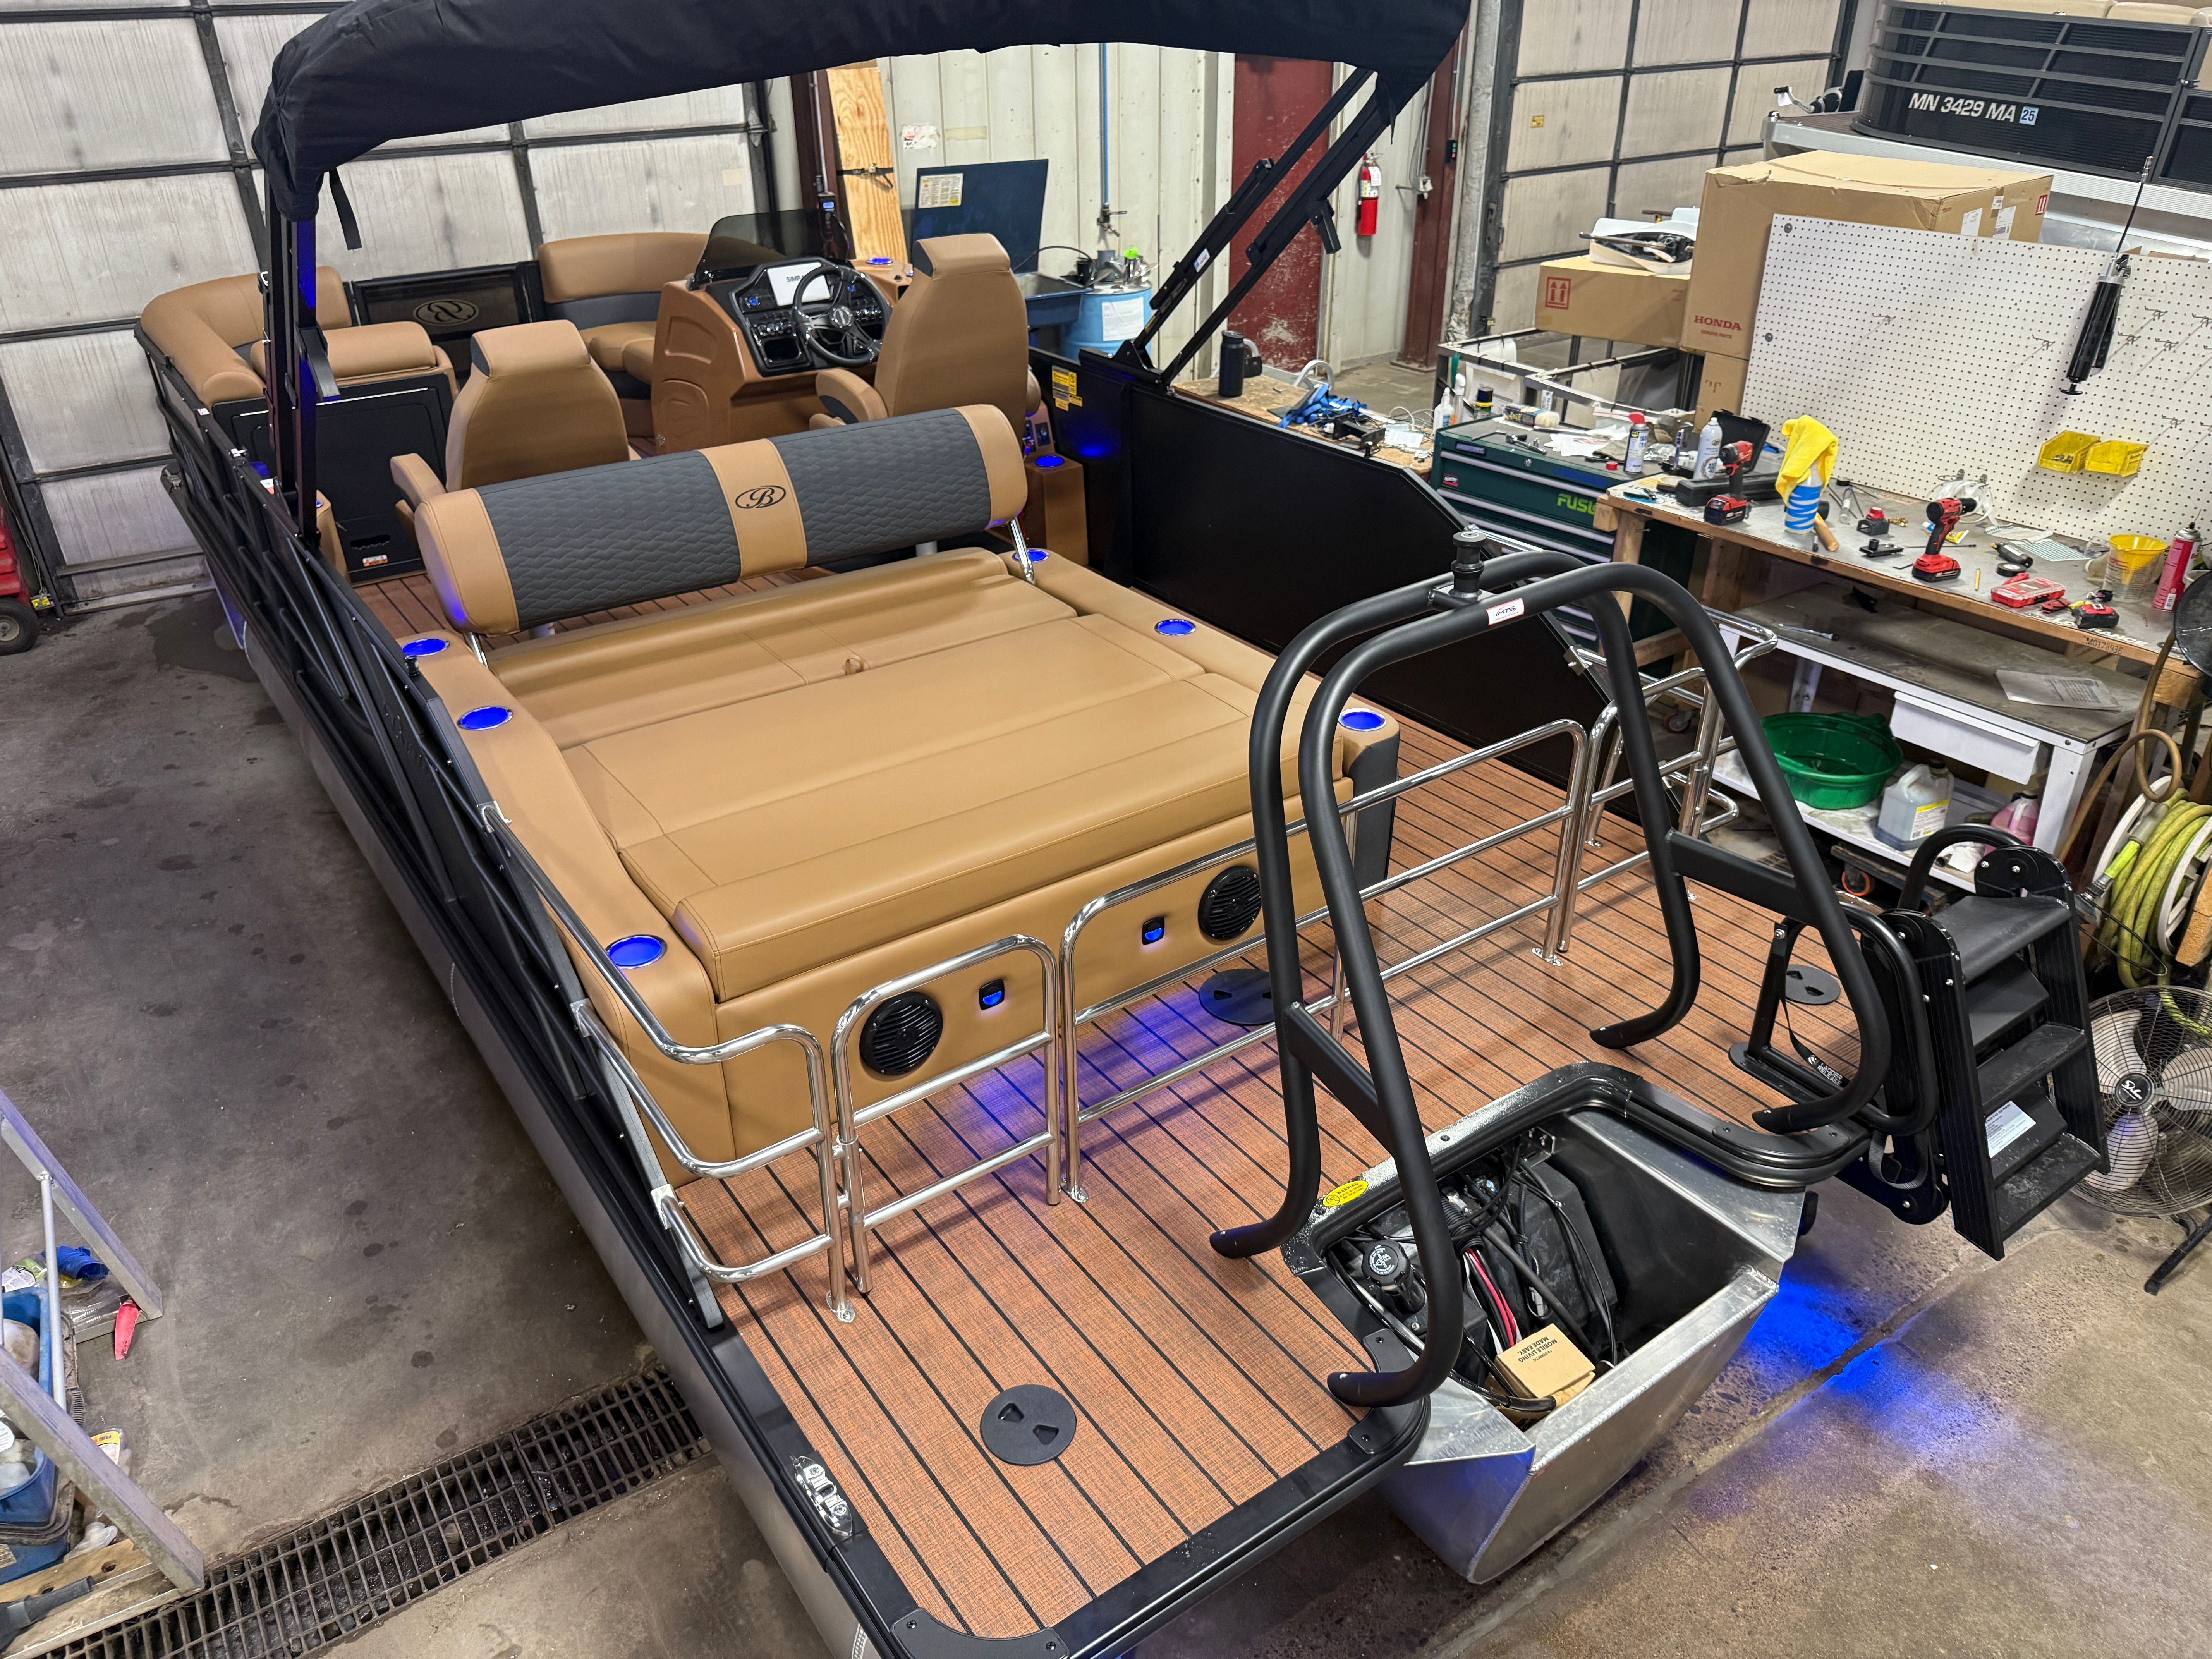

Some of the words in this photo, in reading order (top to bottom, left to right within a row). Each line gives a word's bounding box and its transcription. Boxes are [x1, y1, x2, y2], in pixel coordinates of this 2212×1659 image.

[1908, 92, 1940, 111] MN
[1941, 97, 1985, 117] 3429
[1985, 102, 2016, 122] MA
[2021, 109, 2035, 121] 25
[1694, 315, 1742, 331] HONDA
[1817, 1065, 1842, 1086] RELEASE
[1820, 1063, 1843, 1080] LADDER
[1336, 1182, 1358, 1194] WARNING
[1532, 1336, 1549, 1348] MADE
[1536, 1338, 1558, 1353] MOBILE
[1517, 1345, 1534, 1355] EASY.
[1518, 1350, 1538, 1362] LIVING
[1532, 1352, 1548, 1362] DOMETIC
